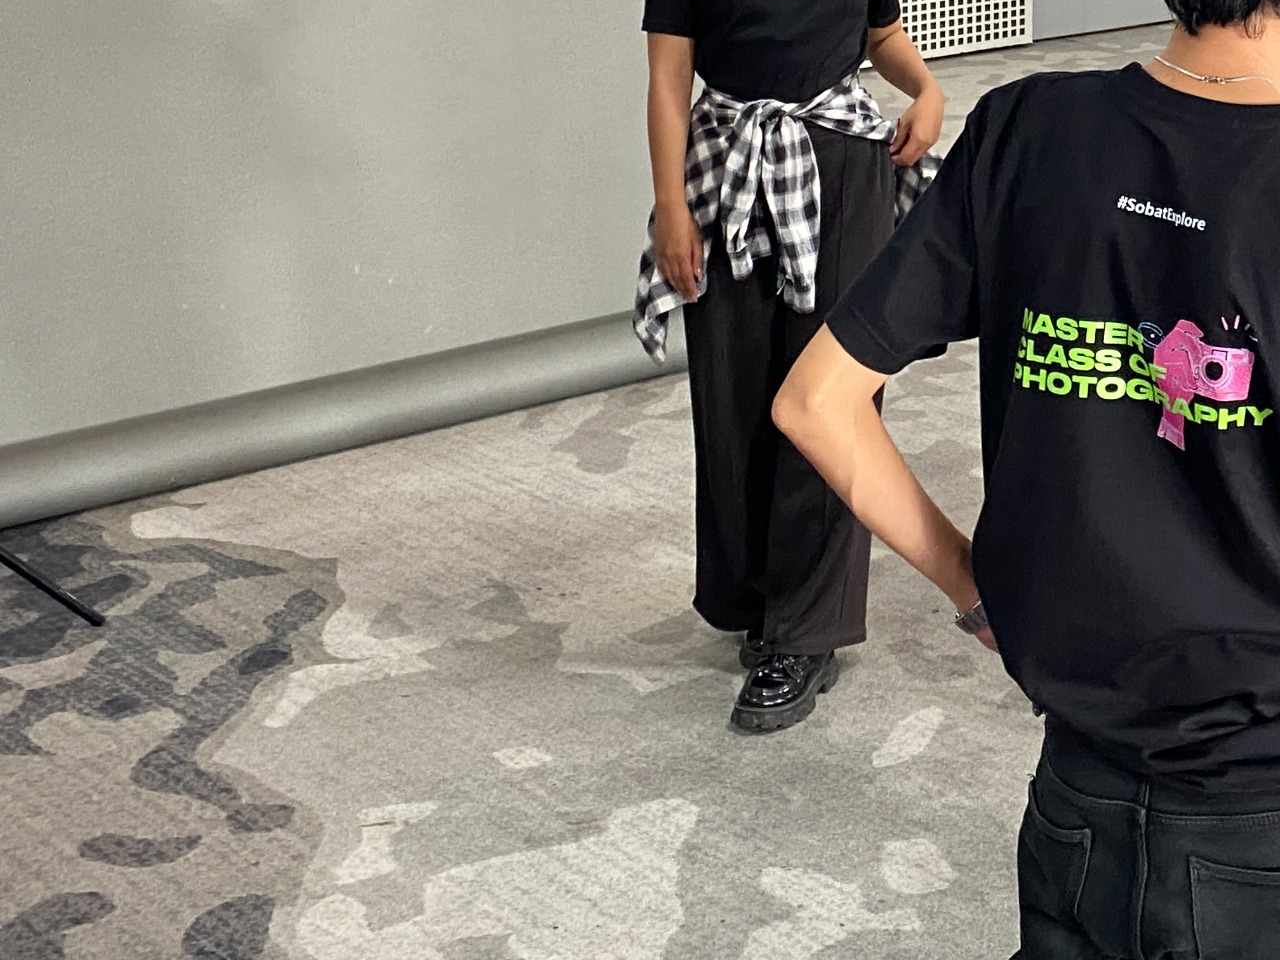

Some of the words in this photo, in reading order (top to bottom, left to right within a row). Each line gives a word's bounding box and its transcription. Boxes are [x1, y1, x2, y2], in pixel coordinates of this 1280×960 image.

[1117, 195, 1206, 231] #SobatExplore
[1018, 335, 1122, 372] CLASS
[1128, 353, 1168, 381] OF
[1012, 361, 1274, 430] PHOTOGRAPHY
